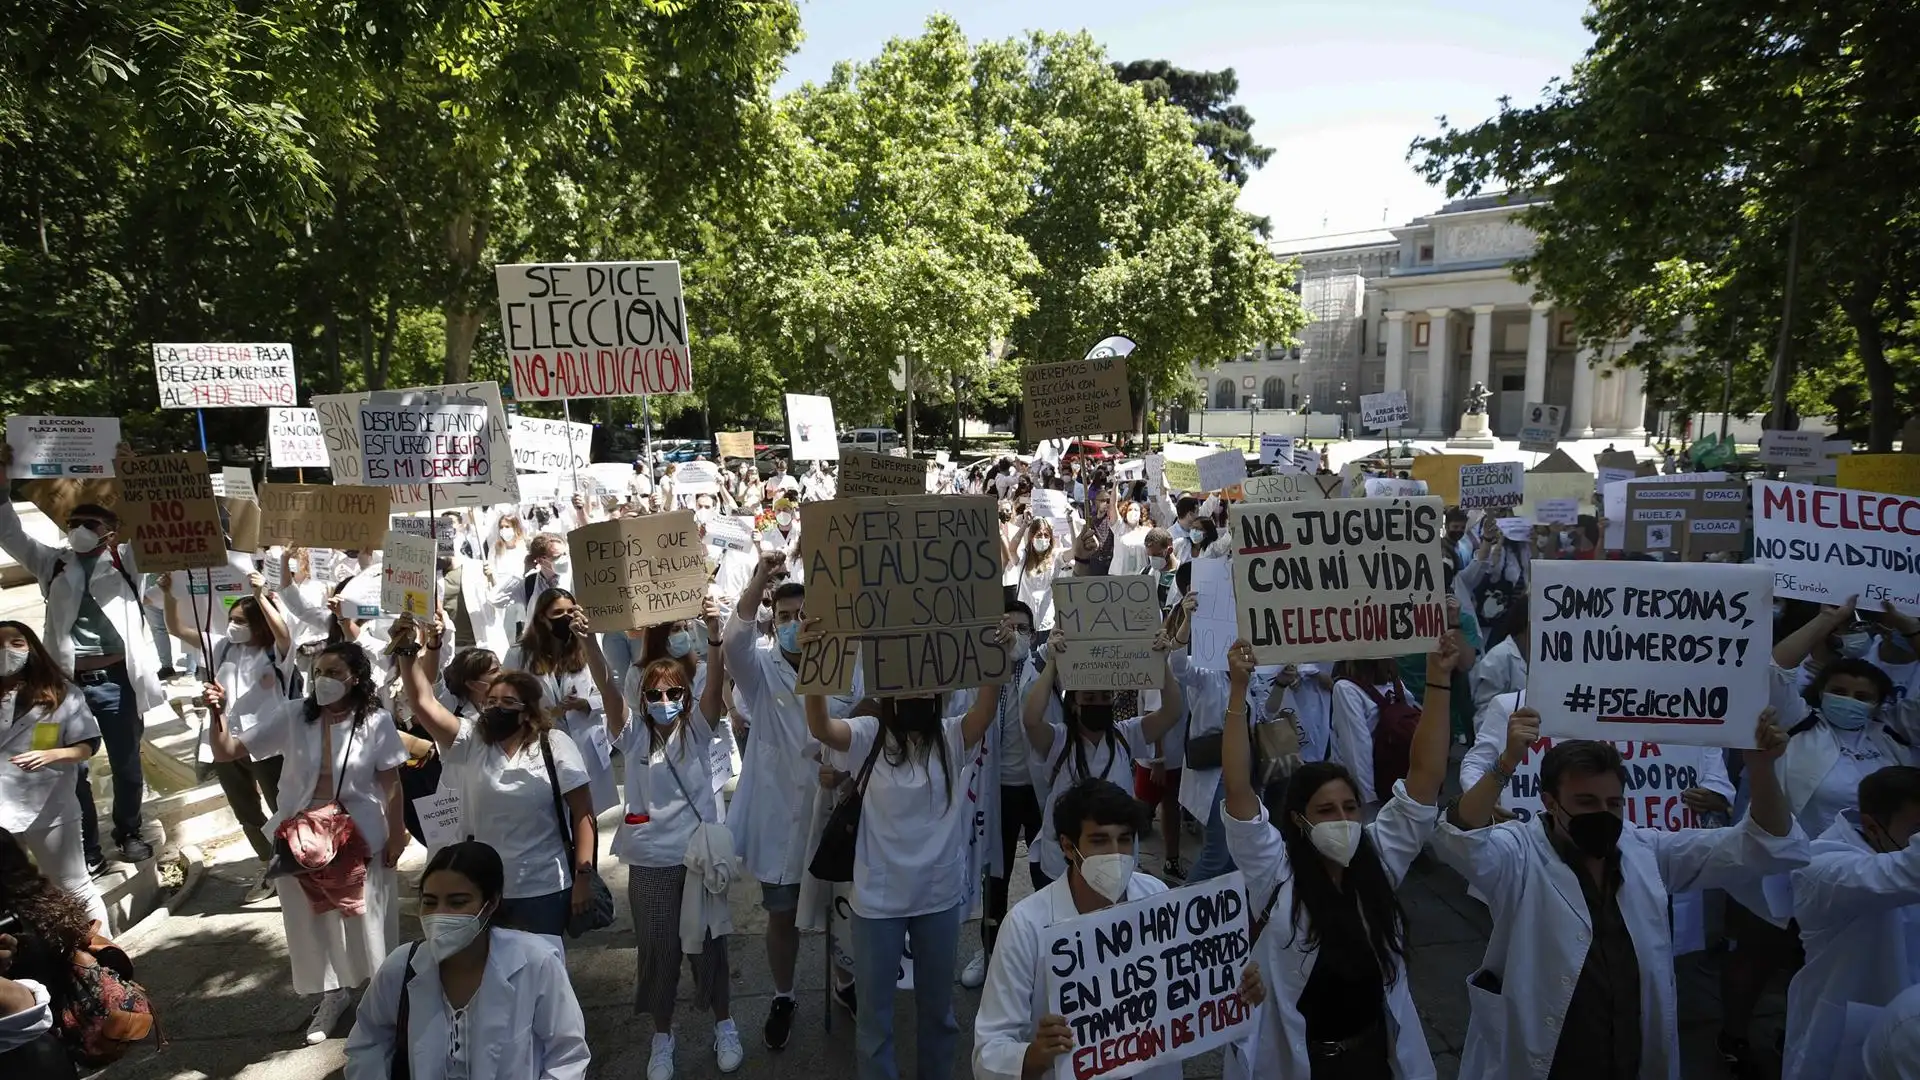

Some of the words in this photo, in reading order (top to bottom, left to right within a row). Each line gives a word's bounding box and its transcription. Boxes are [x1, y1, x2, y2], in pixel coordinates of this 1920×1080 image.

[525, 266, 572, 298] SE
[587, 267, 656, 297] DICE
[157, 348, 179, 362] LA
[254, 347, 289, 362] PASA
[159, 365, 189, 382] DEL
[193, 365, 210, 381] 22
[211, 366, 225, 380] DE
[229, 364, 287, 380] DICIEMBRE
[513, 353, 550, 398] NO
[1026, 363, 1088, 382] QUEREMOS
[1093, 359, 1116, 371] UNA
[163, 388, 186, 406] AL
[192, 384, 210, 405] 17
[215, 385, 235, 405] DE
[239, 383, 294, 404] JUNIO
[1078, 379, 1096, 390] CON
[300, 412, 317, 423] YA
[319, 401, 353, 426] SIN
[361, 408, 416, 432] DESPUÉS
[419, 413, 435, 433] DE
[438, 412, 485, 433] TANTO
[272, 424, 320, 437] FUNCION
[519, 419, 538, 433] SU
[326, 426, 360, 451] SIN
[364, 434, 432, 455] ESFUERZO
[436, 435, 486, 455] ELEGIR
[121, 458, 191, 475] CAROLINA
[333, 456, 359, 478] NO
[368, 459, 390, 479] ES
[394, 456, 415, 478] MI
[421, 458, 489, 479] DERECHO
[514, 448, 541, 464] NOT
[844, 456, 860, 467] LA
[843, 471, 921, 486] ESPECIALIZADA
[148, 488, 162, 501] DE
[184, 486, 211, 500] QUE
[337, 493, 376, 515] OPACA
[1705, 490, 1742, 500] OPACA
[150, 501, 185, 522] NO
[1638, 510, 1672, 519] HUELE
[1675, 510, 1683, 518] A
[135, 520, 218, 540] ARRANCA
[320, 520, 370, 543] CLOACA
[394, 519, 425, 529] ERROR
[827, 510, 904, 543] AYER
[915, 508, 989, 540] ERAN
[1241, 512, 1285, 548] NO
[1693, 522, 1737, 531] CLOACA
[142, 541, 162, 554] LA
[166, 537, 209, 554] WEB
[586, 534, 642, 562] PEDÍS
[657, 531, 689, 549] QUE
[1755, 536, 1787, 560] NO
[1789, 538, 1820, 562] SU
[584, 566, 617, 587] NOS
[629, 554, 705, 580] APLAUDAN
[810, 539, 997, 589] APLAUSOS
[1247, 555, 1314, 592] CON
[1318, 549, 1349, 590] MI
[1358, 545, 1435, 591] VIDA
[617, 584, 650, 600] PERO
[656, 580, 676, 591] NOS
[631, 602, 641, 613] A
[646, 588, 702, 611] PATADAS
[1055, 581, 1150, 604] TODO
[834, 589, 891, 630] HOY
[912, 584, 976, 626] SON
[1542, 584, 1617, 622] SOMOS
[1622, 585, 1755, 629] PERSONAS,
[1057, 607, 1148, 633] MAL
[1249, 607, 1283, 646] LA
[1282, 595, 1388, 645] ELECCIÓN
[1540, 630, 1573, 663] NO
[1583, 624, 1750, 668] NÚMEROS!!
[423, 806, 459, 820] INCOMPET
[1051, 931, 1085, 978] SI
[1094, 919, 1133, 964] NO
[1138, 901, 1181, 946] HAY
[1185, 888, 1242, 935] COVID
[1059, 975, 1102, 1015] EN
[1110, 954, 1158, 999] LAS
[1070, 989, 1158, 1047] TAMPOCO
[1166, 972, 1200, 1011] EN
[1208, 964, 1236, 996] LA
[1072, 1019, 1166, 1080] ELECCIÓN
[1170, 1012, 1196, 1049] DE
[1197, 991, 1250, 1038] PLAZA
